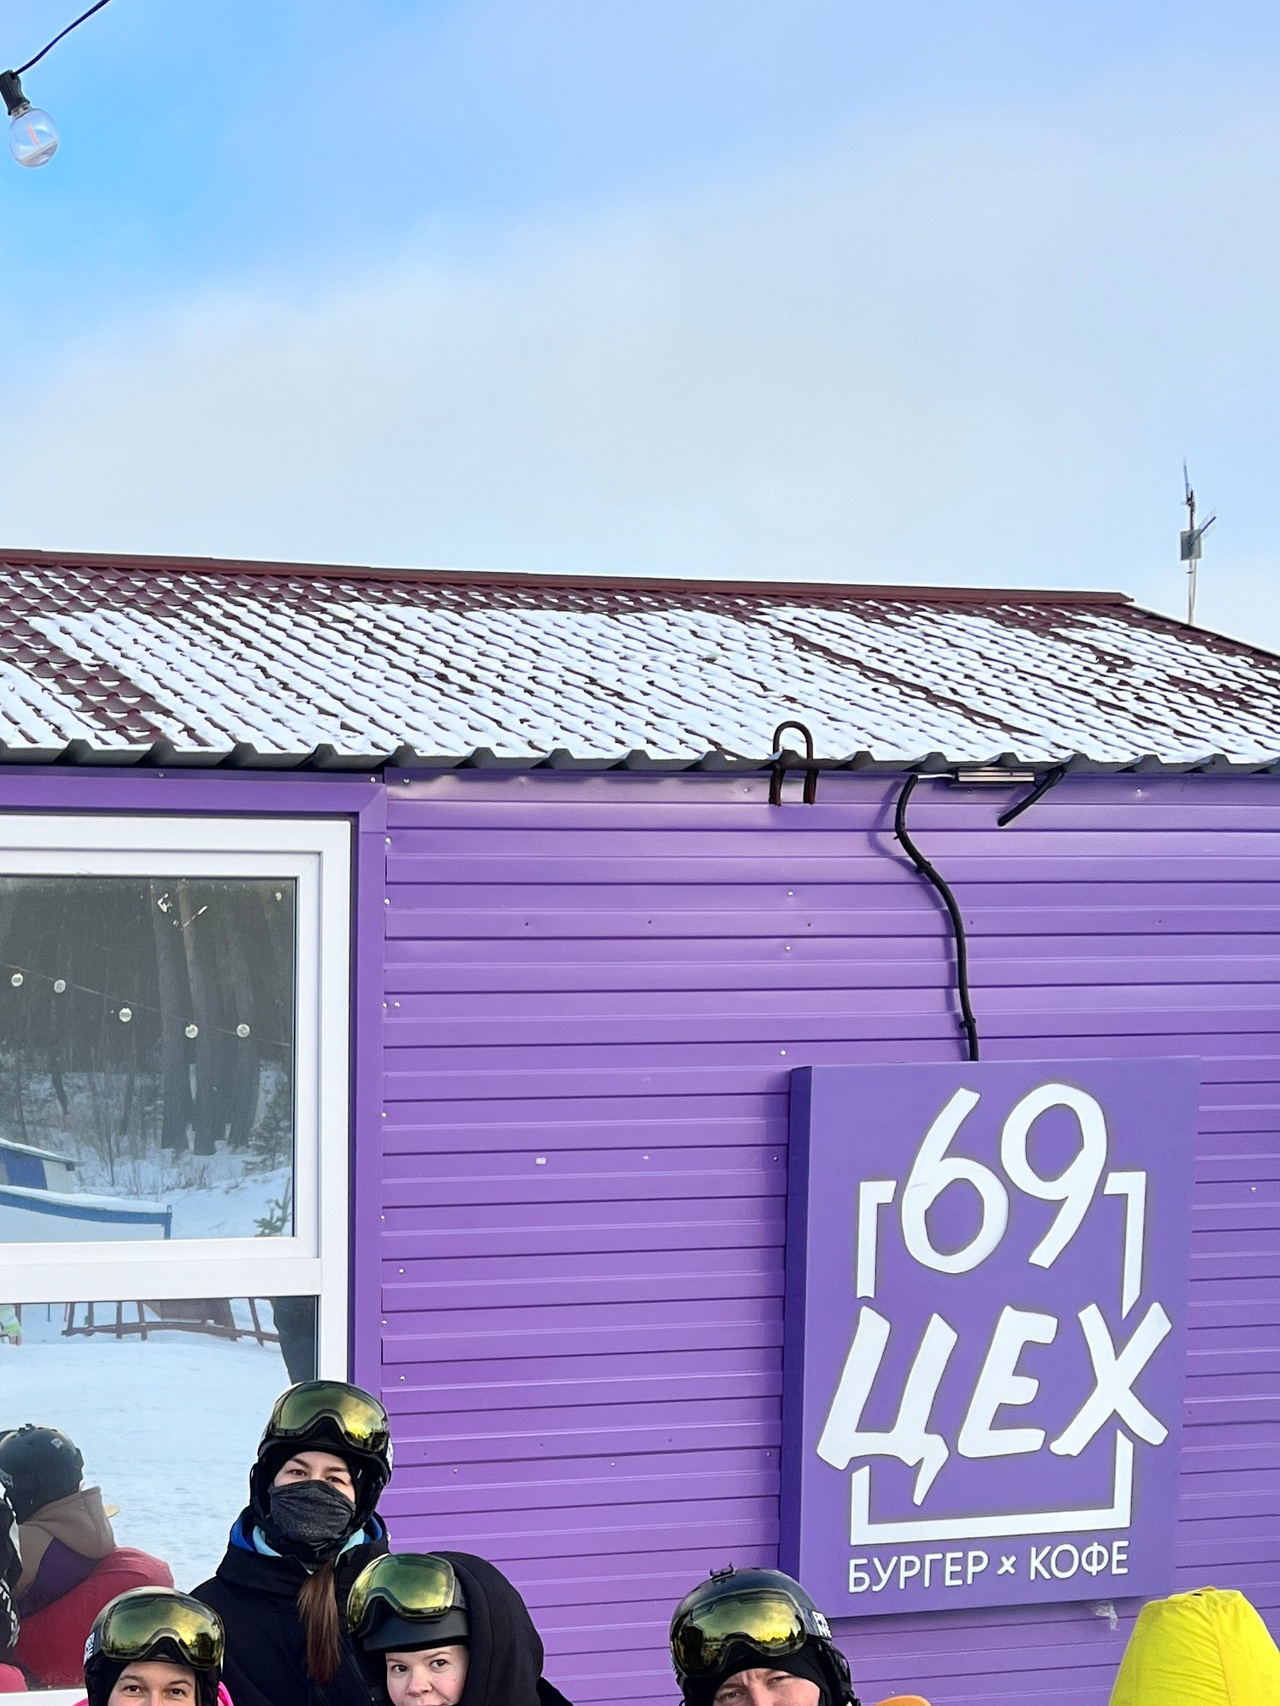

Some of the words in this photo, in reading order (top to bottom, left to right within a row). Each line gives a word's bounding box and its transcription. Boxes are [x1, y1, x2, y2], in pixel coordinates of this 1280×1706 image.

[902, 1083, 1108, 1274] 69
[816, 1302, 1173, 1507] ЦЕХ
[848, 1549, 989, 1593] БУРГЕР
[1029, 1540, 1131, 1582] КОФЕ
